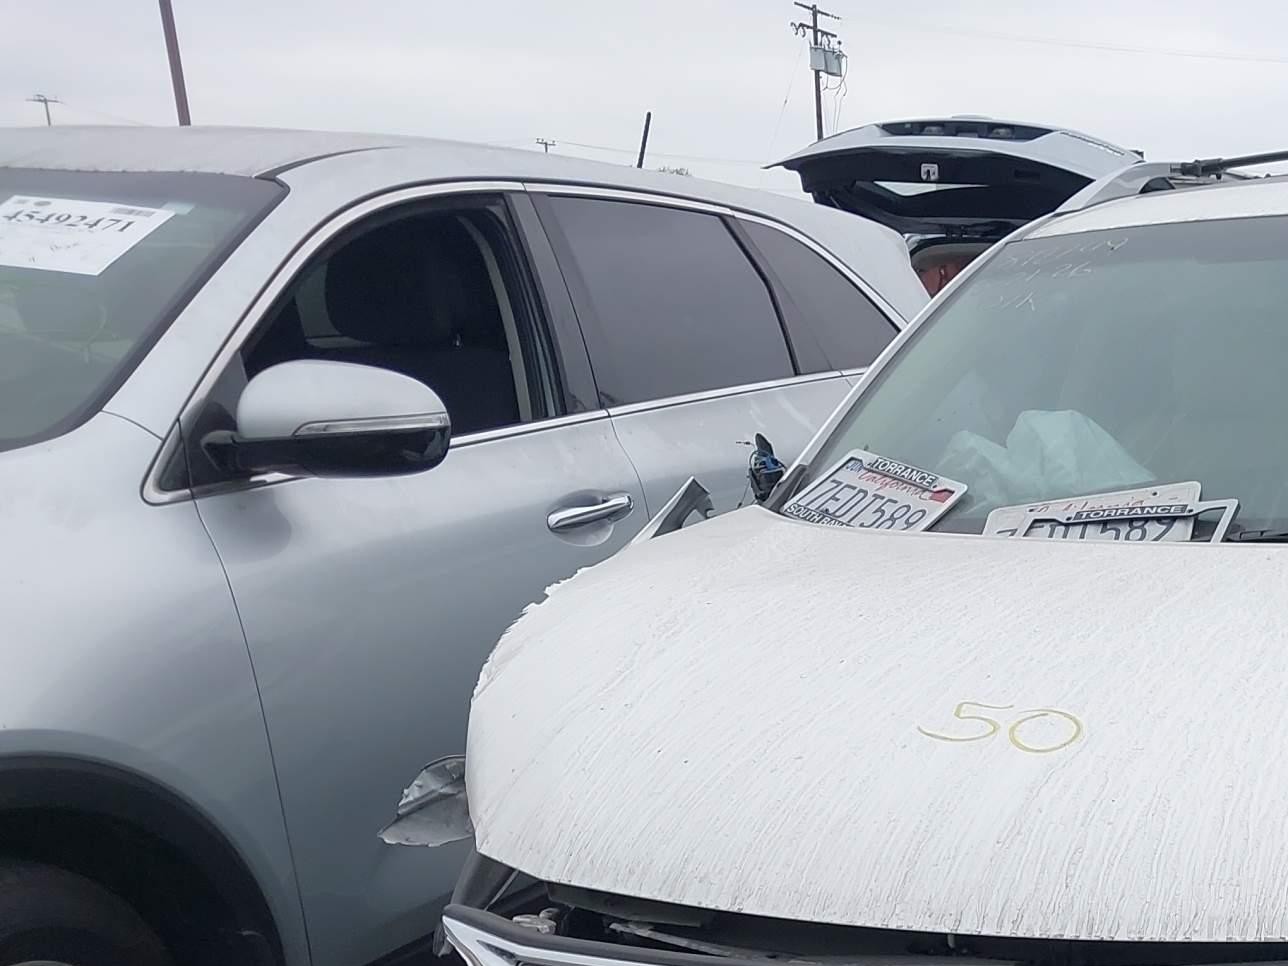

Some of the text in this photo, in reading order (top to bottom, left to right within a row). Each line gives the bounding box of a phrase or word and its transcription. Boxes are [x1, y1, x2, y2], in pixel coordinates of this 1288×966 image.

[2, 209, 136, 233] 45492471
[873, 457, 937, 487] TORRANCE
[786, 503, 823, 526] SOUTH
[1078, 504, 1184, 520] TORRANCE
[917, 701, 1083, 753] 50
